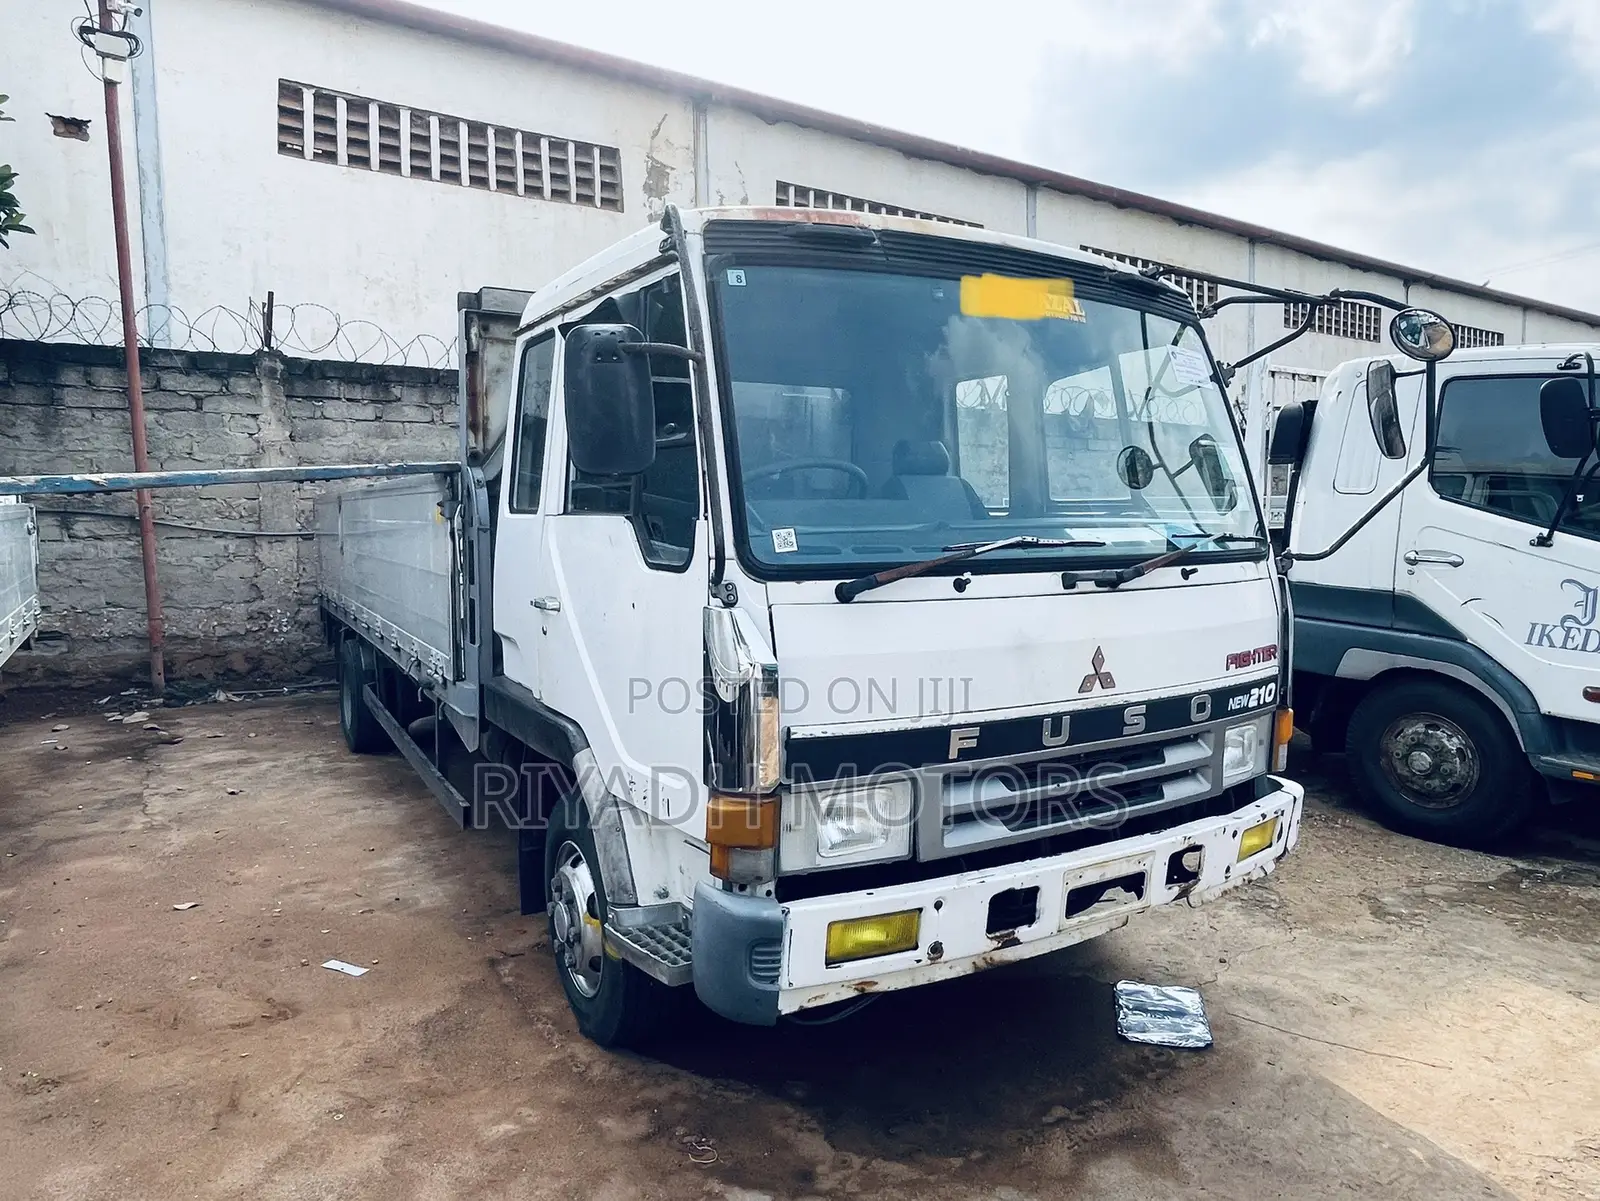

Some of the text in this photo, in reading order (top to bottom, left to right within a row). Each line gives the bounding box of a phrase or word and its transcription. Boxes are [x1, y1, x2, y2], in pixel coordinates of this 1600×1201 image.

[735, 274, 743, 284] 8
[1524, 621, 1600, 654] IKED
[1225, 644, 1277, 671] FIGHTER
[1227, 682, 1276, 711] NEW 210
[948, 693, 1212, 760] FUSO
